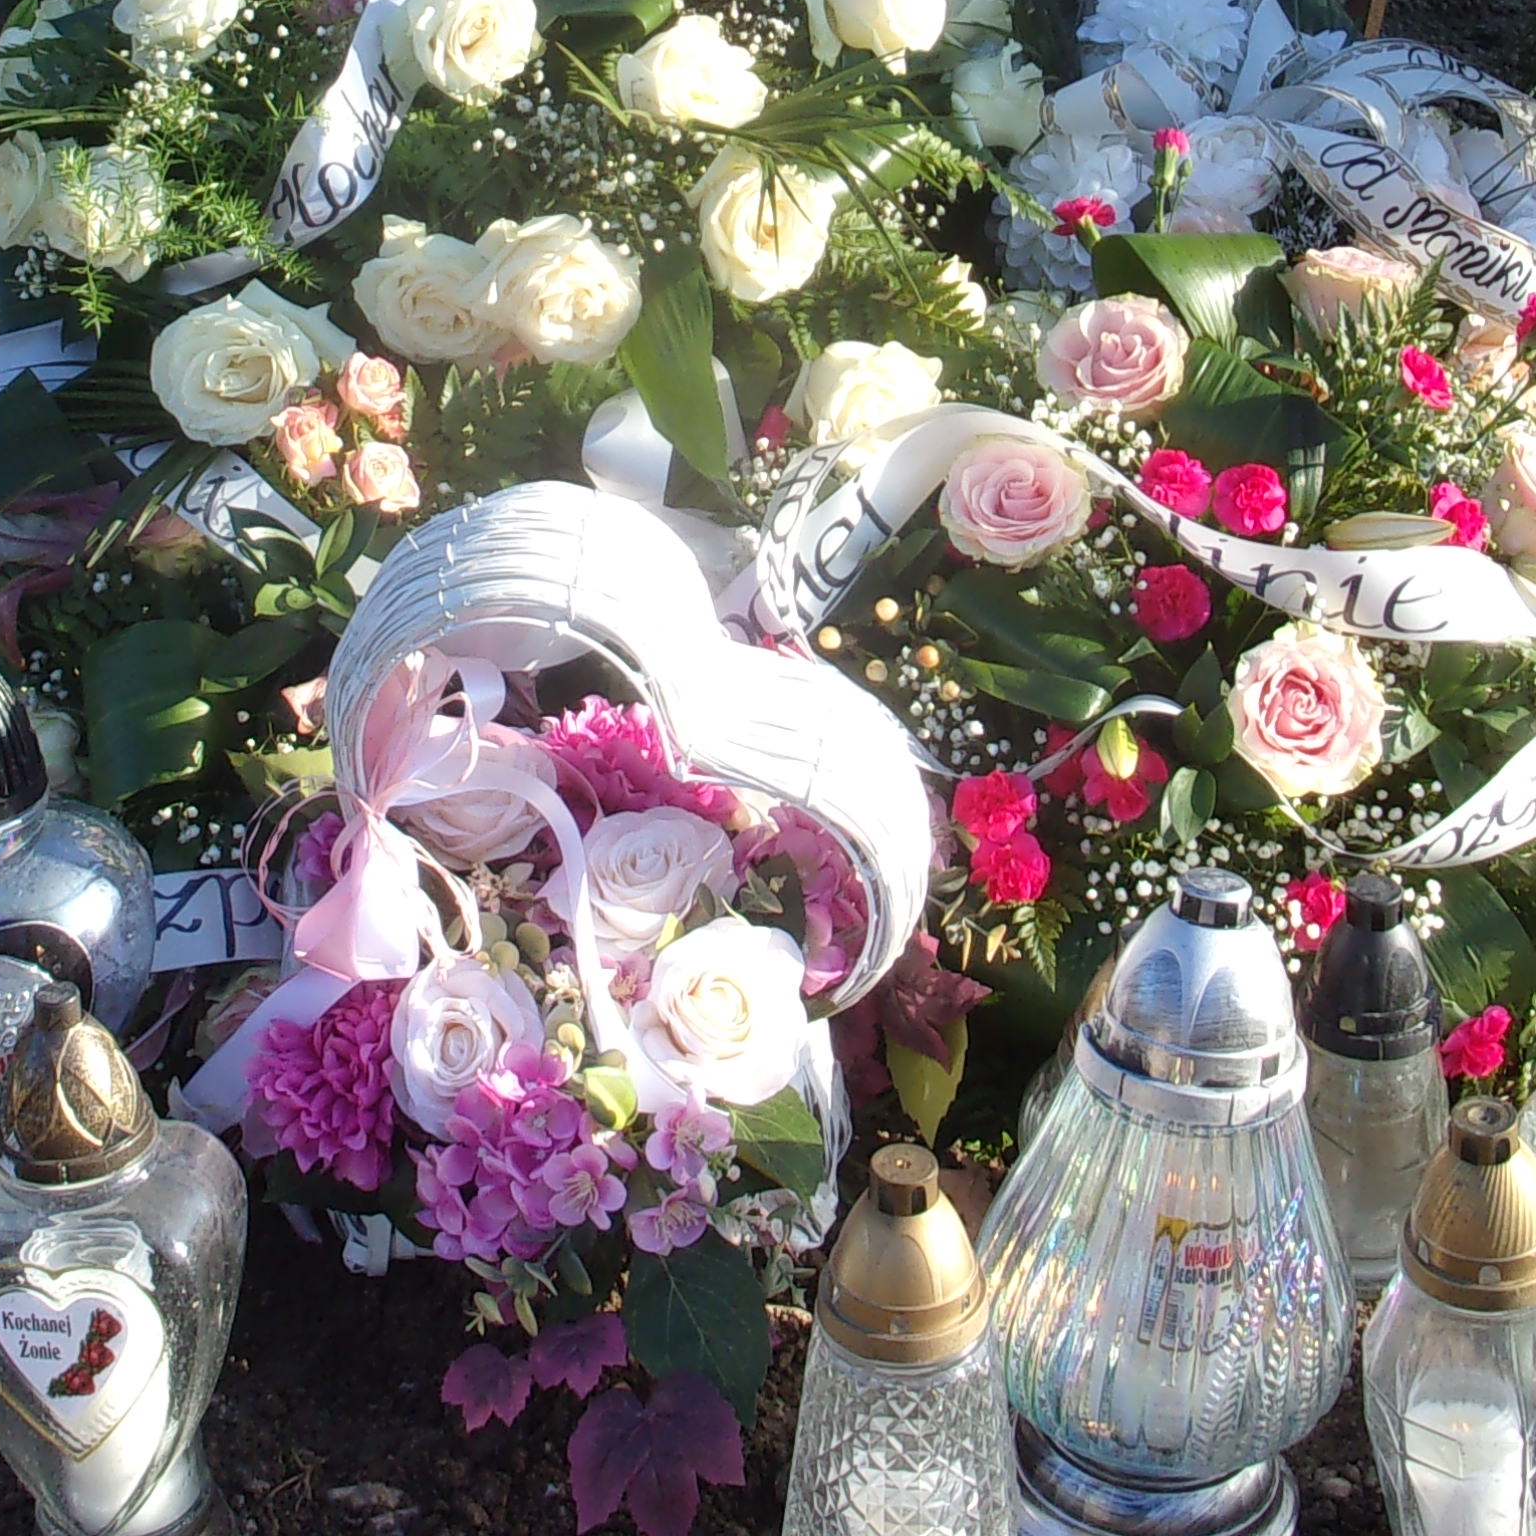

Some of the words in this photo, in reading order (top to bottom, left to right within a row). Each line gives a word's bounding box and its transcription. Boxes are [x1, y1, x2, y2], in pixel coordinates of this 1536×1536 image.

[1320, 140, 1401, 202] Od
[0, 1308, 73, 1338] Kochanej
[18, 1333, 62, 1364] Żonie
